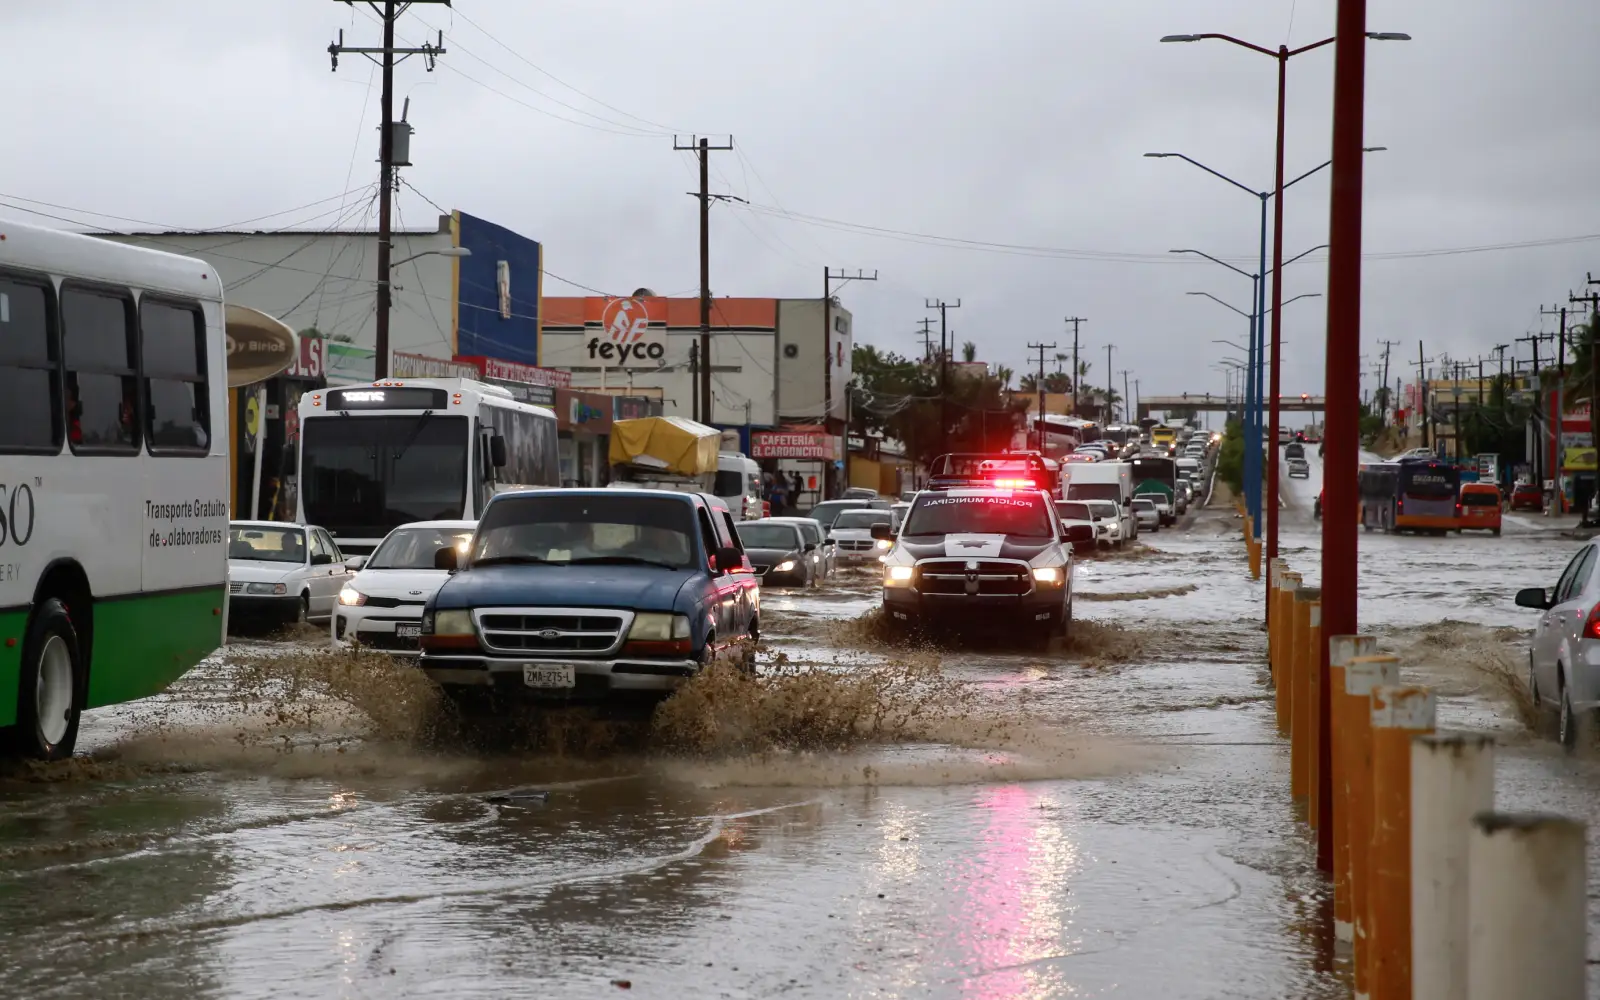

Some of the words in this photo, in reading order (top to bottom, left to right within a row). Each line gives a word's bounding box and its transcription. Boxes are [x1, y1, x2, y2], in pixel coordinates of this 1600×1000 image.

[587, 337, 664, 365] feyco
[760, 434, 815, 446] CAFETERÍA
[752, 446, 761, 457] EL
[146, 500, 192, 523] Transporte
[194, 499, 226, 517] Gratuito
[150, 528, 160, 547] de
